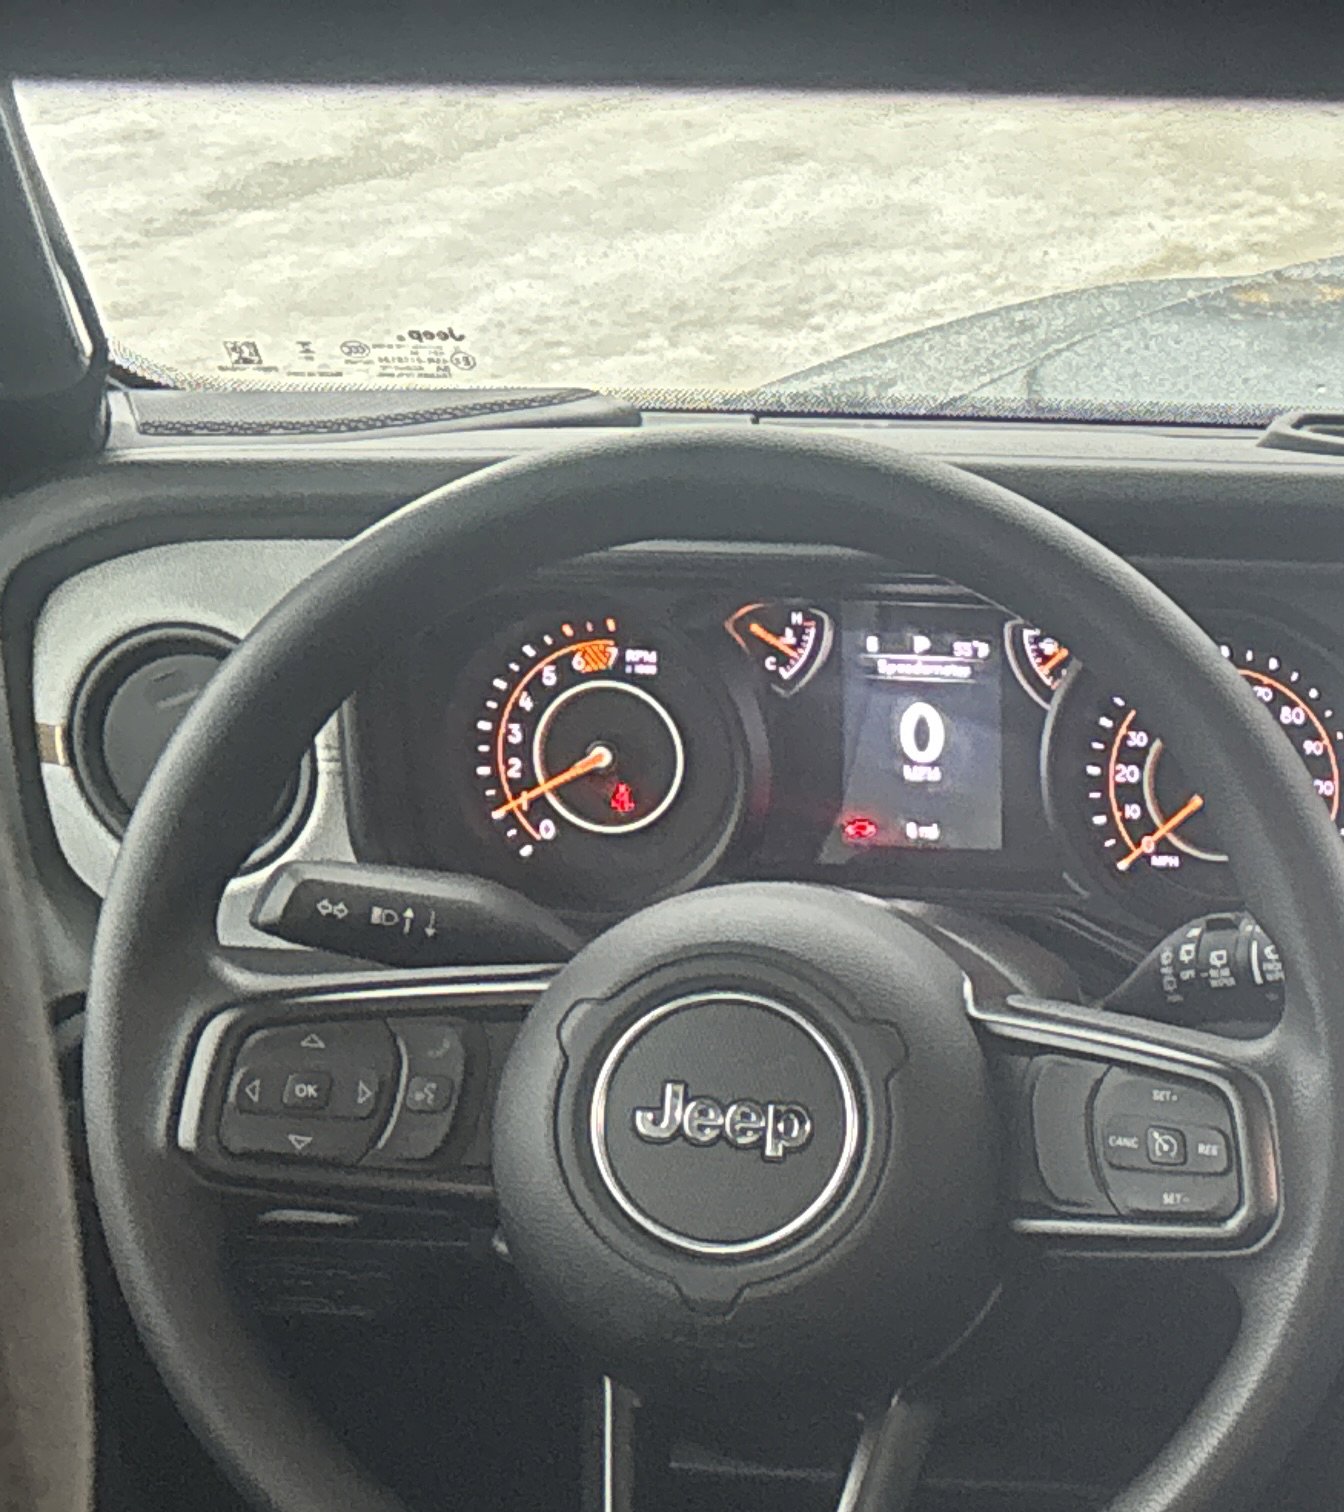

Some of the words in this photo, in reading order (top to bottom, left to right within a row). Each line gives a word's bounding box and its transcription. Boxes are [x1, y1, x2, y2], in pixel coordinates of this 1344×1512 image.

[571, 652, 586, 671] 6
[541, 665, 557, 686] 5
[518, 691, 534, 711] 4
[1280, 705, 1306, 725] 80
[507, 723, 523, 744] 3
[899, 701, 945, 763] 0
[1127, 731, 1149, 748] 30
[1303, 740, 1324, 756] 90
[507, 757, 522, 778] 2
[1115, 764, 1140, 784] 20
[1124, 804, 1141, 820] 10
[538, 819, 556, 840] 0
[294, 1083, 318, 1098] OK
[635, 1081, 813, 1160] Jeep
